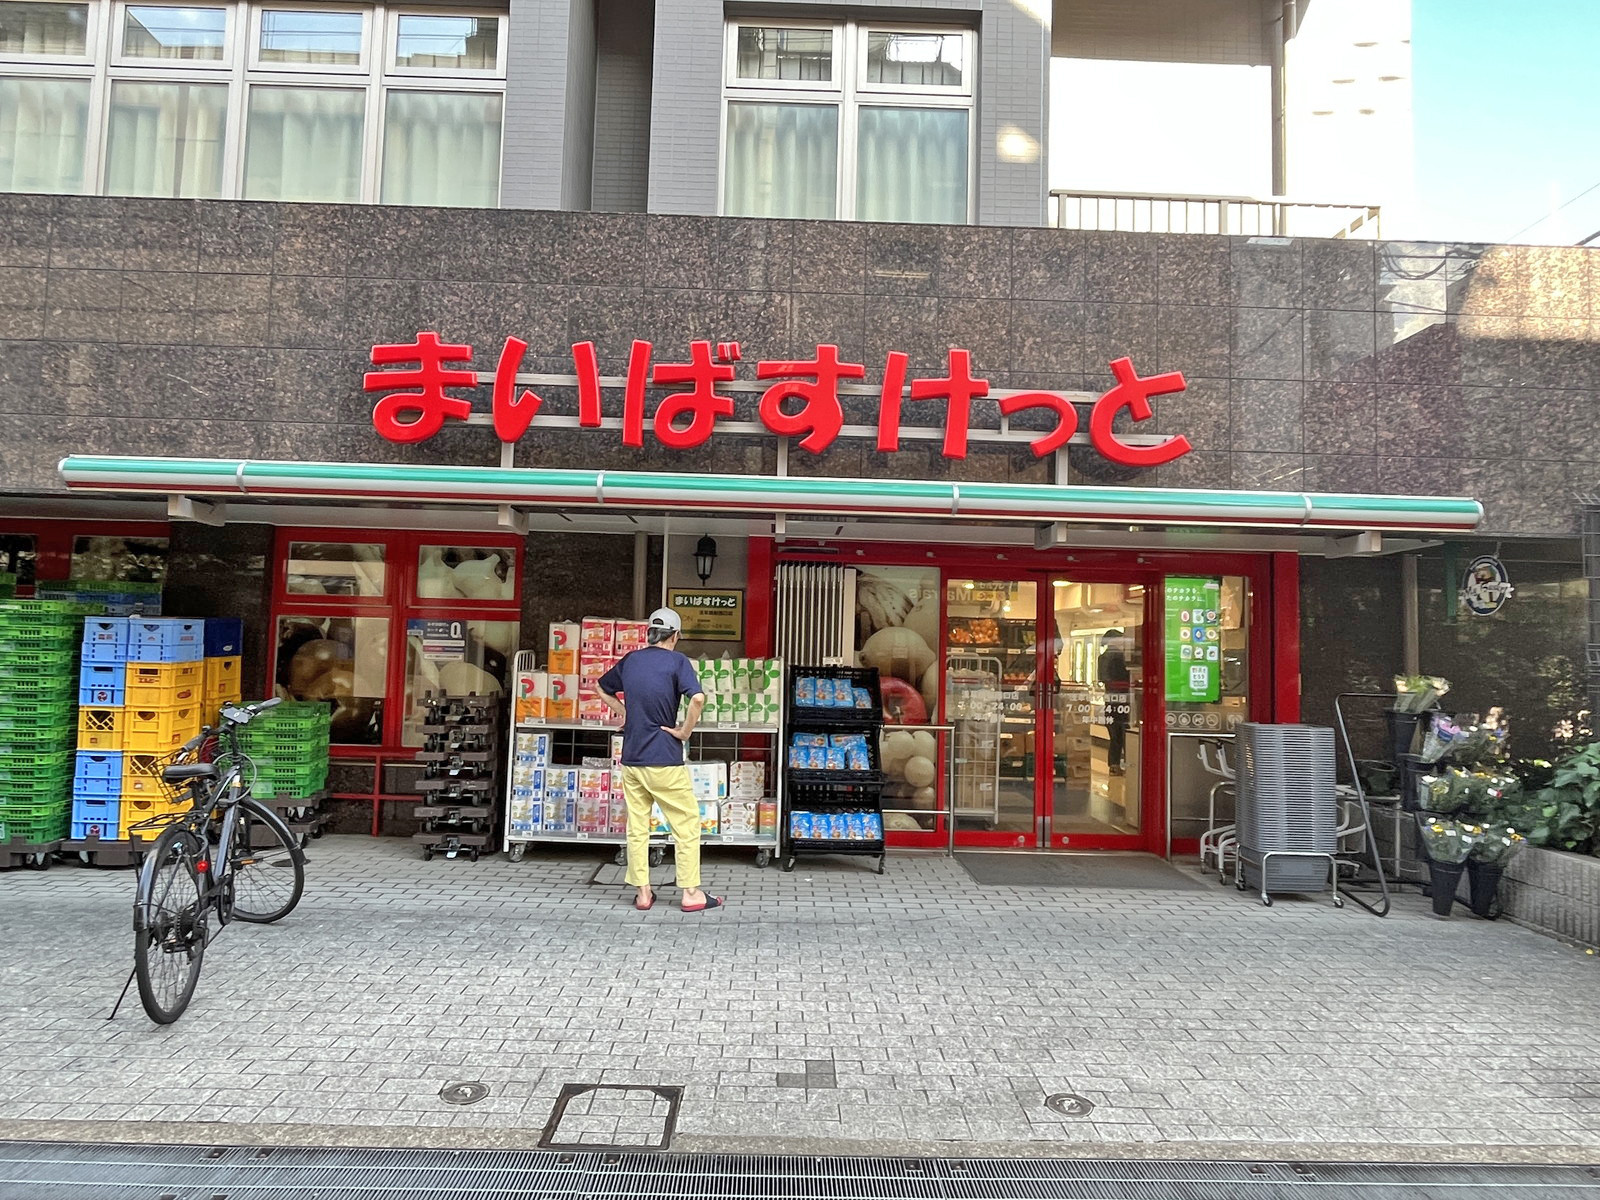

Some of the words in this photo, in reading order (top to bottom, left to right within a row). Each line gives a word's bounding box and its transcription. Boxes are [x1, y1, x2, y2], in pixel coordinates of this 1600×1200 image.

[363, 331, 1192, 466] まいばすけっと
[675, 596, 736, 607] まいばすけっと
